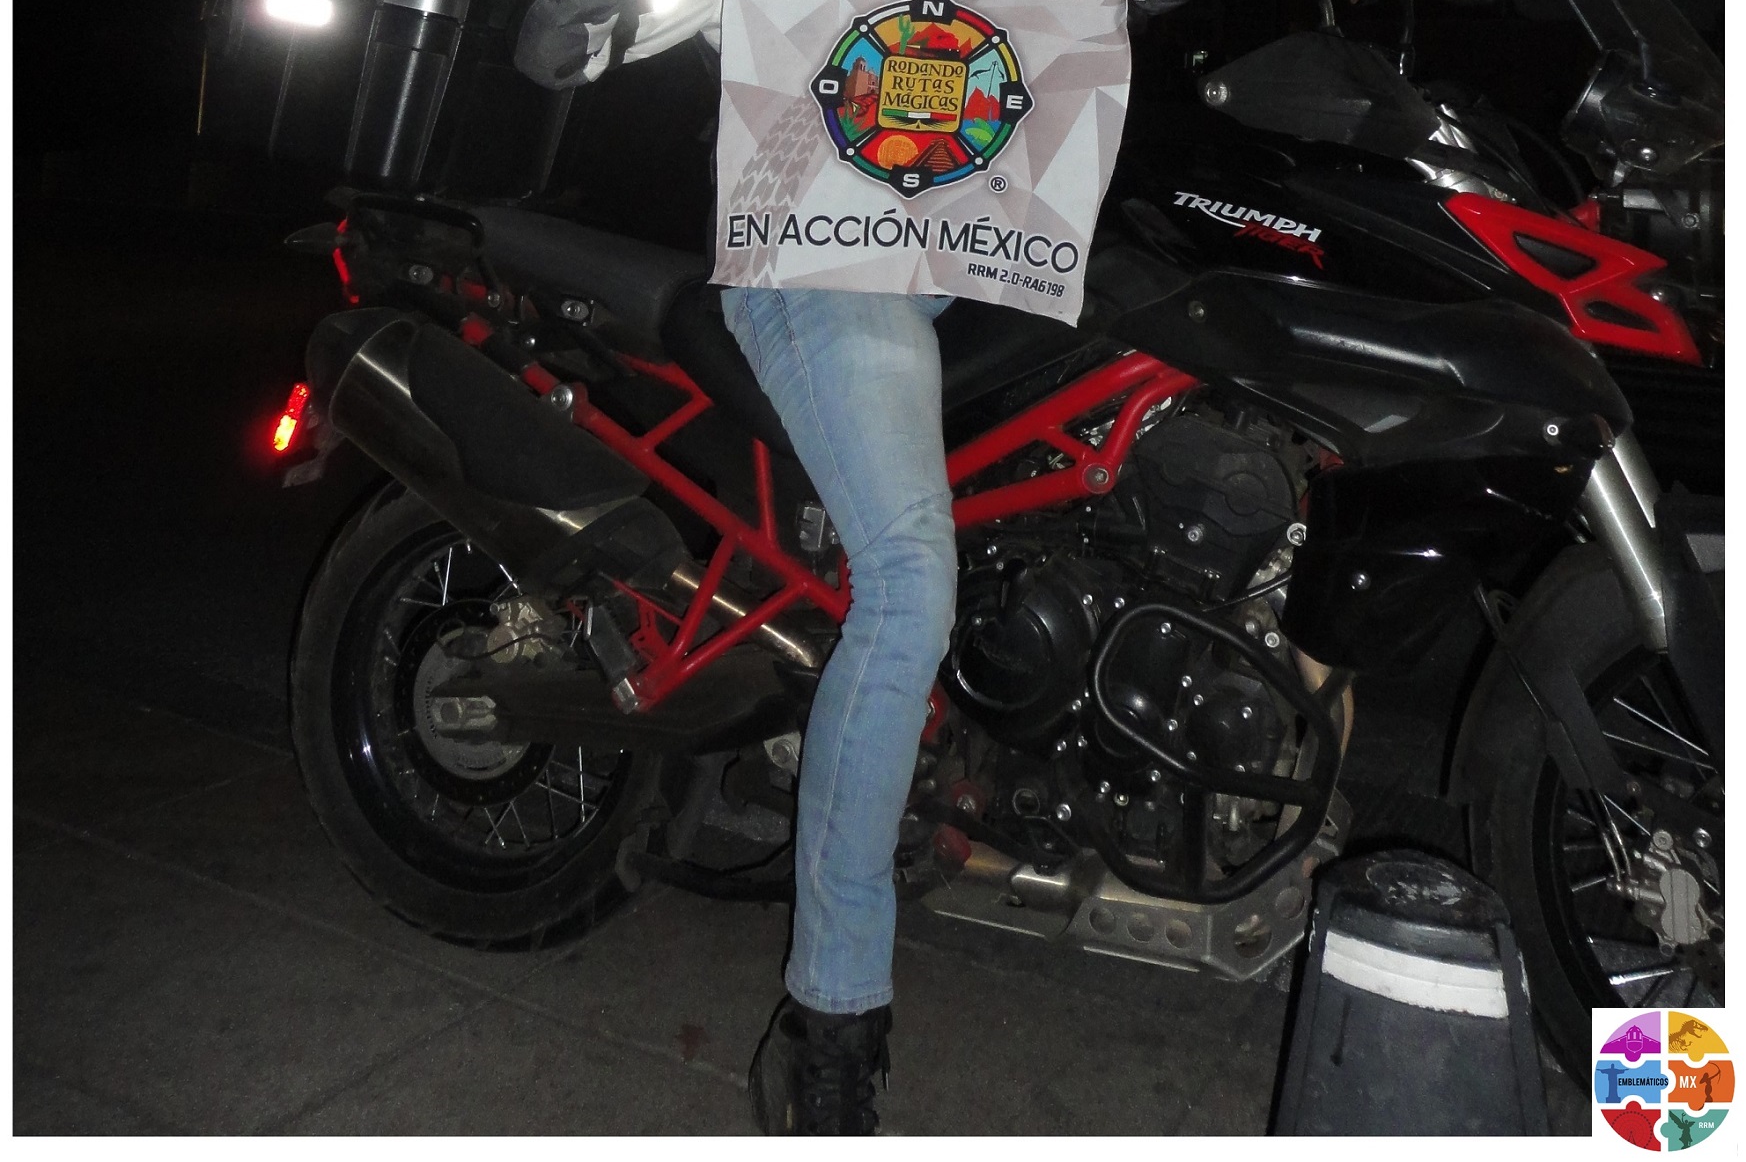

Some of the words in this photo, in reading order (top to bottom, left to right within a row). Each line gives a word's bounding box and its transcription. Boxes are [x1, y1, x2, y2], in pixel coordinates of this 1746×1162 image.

[923, 1, 944, 16] N
[818, 80, 839, 95] O
[1007, 94, 1023, 109] E
[903, 174, 919, 188] S
[1173, 191, 1322, 243] TRIUMPH
[727, 214, 769, 248] EN
[778, 209, 928, 250] ACCIÓN
[938, 216, 1078, 273] MÉXICO
[1233, 222, 1325, 270] TIGER
[967, 262, 999, 280] RRM
[999, 268, 1066, 298] 2.0-RA6198
